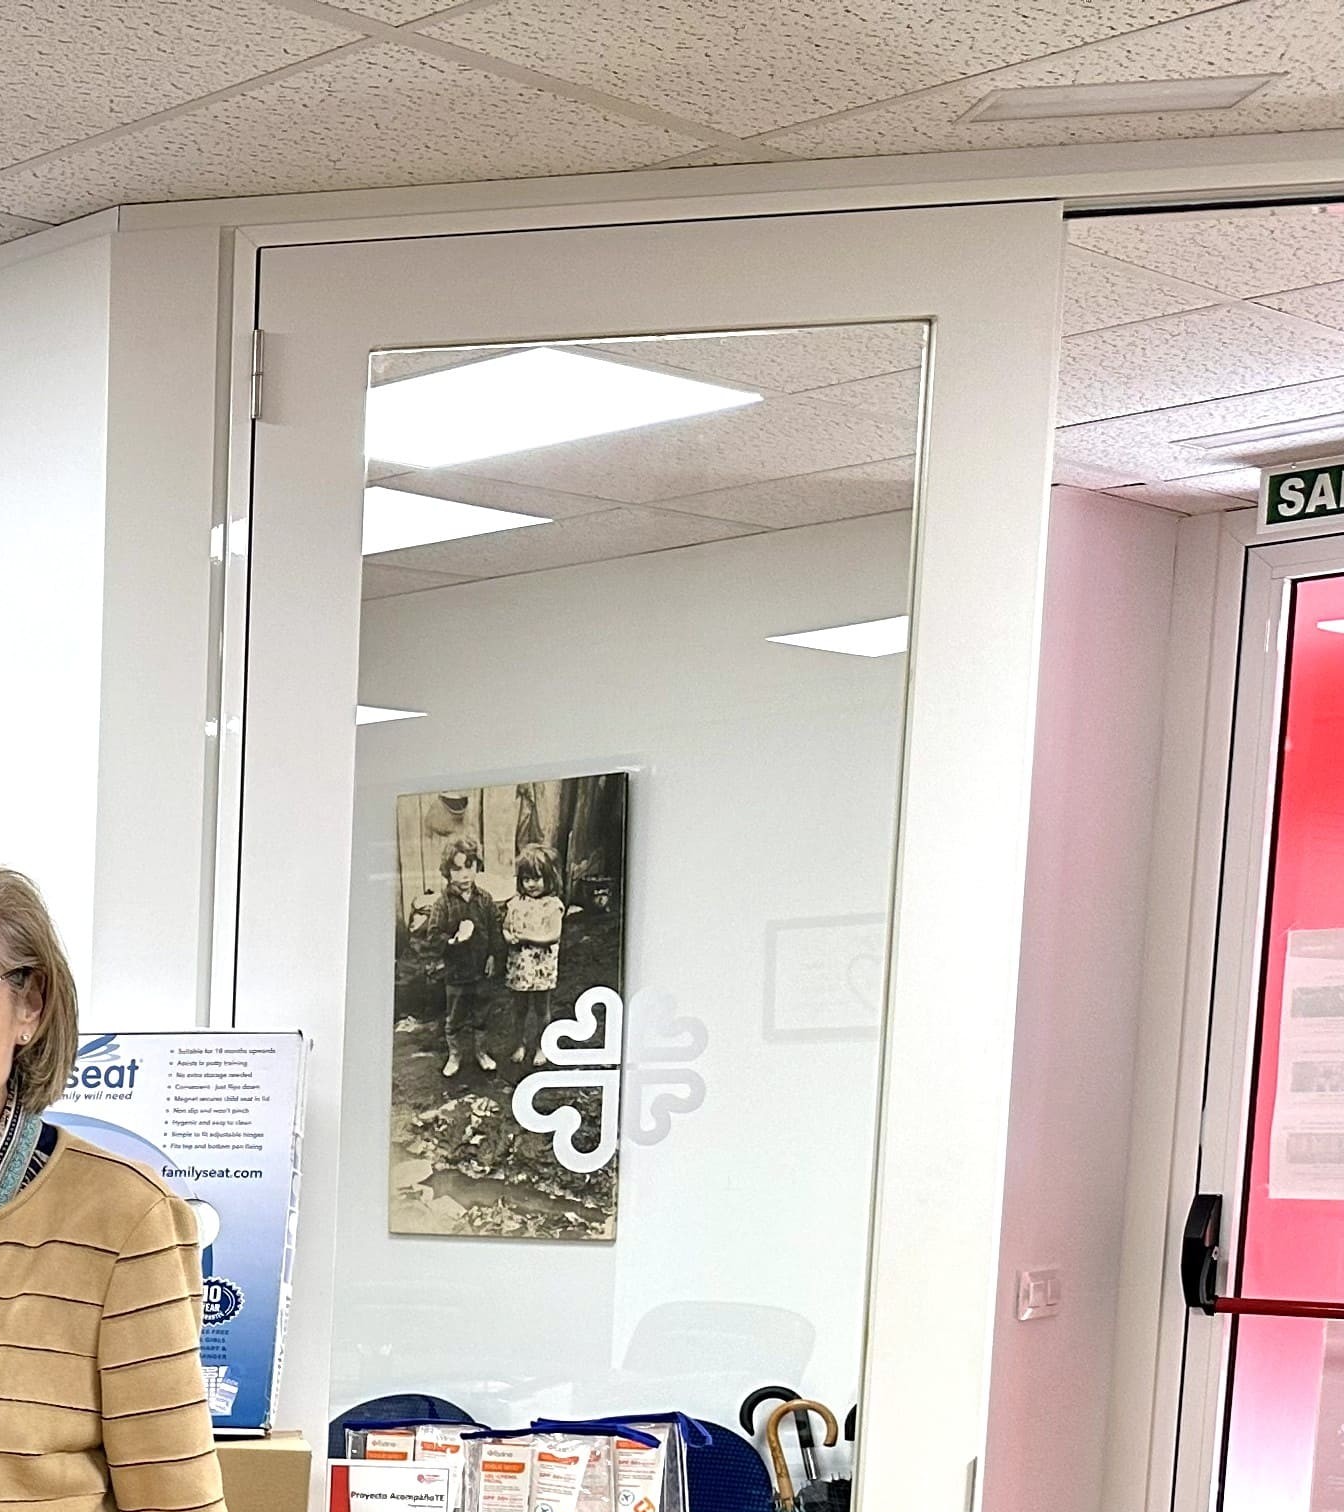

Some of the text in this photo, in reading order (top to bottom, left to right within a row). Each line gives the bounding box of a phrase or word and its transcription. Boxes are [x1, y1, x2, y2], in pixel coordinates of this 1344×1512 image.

[1277, 470, 1344, 517] SA
[84, 1090, 103, 1101] will
[105, 1090, 133, 1101] need
[161, 1165, 263, 1181] familyseat.com
[351, 1491, 388, 1500] Proyecto
